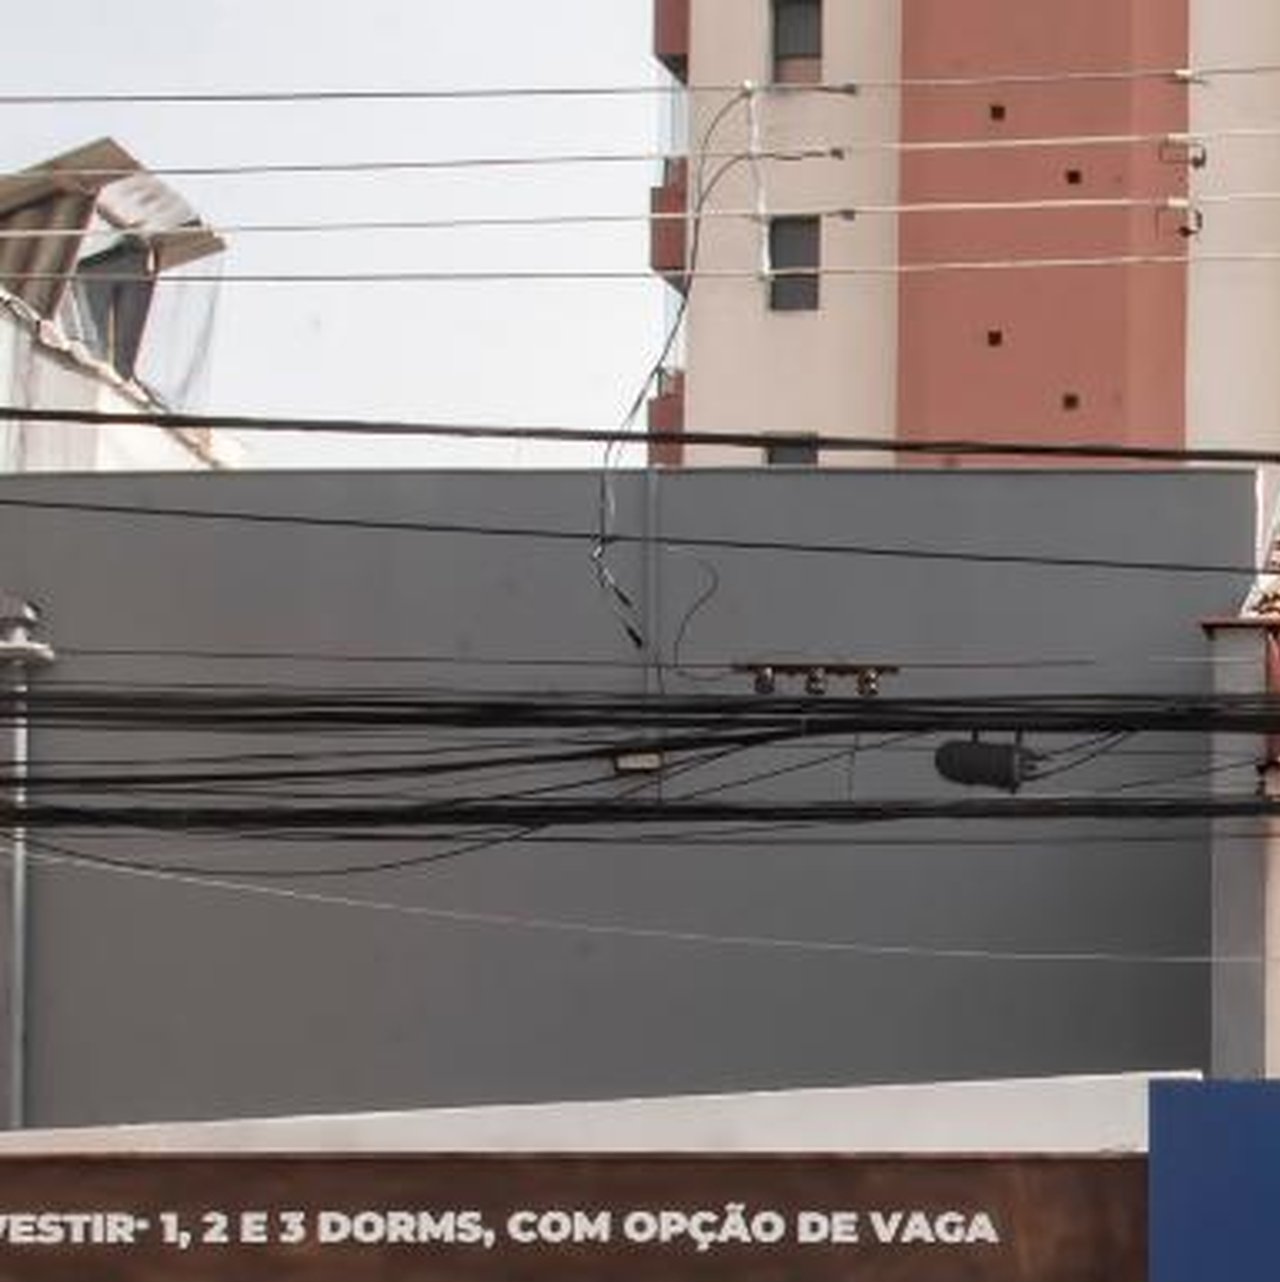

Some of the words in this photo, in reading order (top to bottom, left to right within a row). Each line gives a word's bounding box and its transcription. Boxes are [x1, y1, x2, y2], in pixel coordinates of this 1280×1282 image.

[201, 1212, 230, 1243] 2
[239, 1212, 269, 1243] E
[279, 1212, 305, 1244] 3
[317, 1211, 496, 1248] DORMS,
[506, 1211, 612, 1244] COM
[623, 1202, 786, 1252] OPÇÃO
[797, 1212, 859, 1243] DE
[869, 1211, 1000, 1244] VAGA
